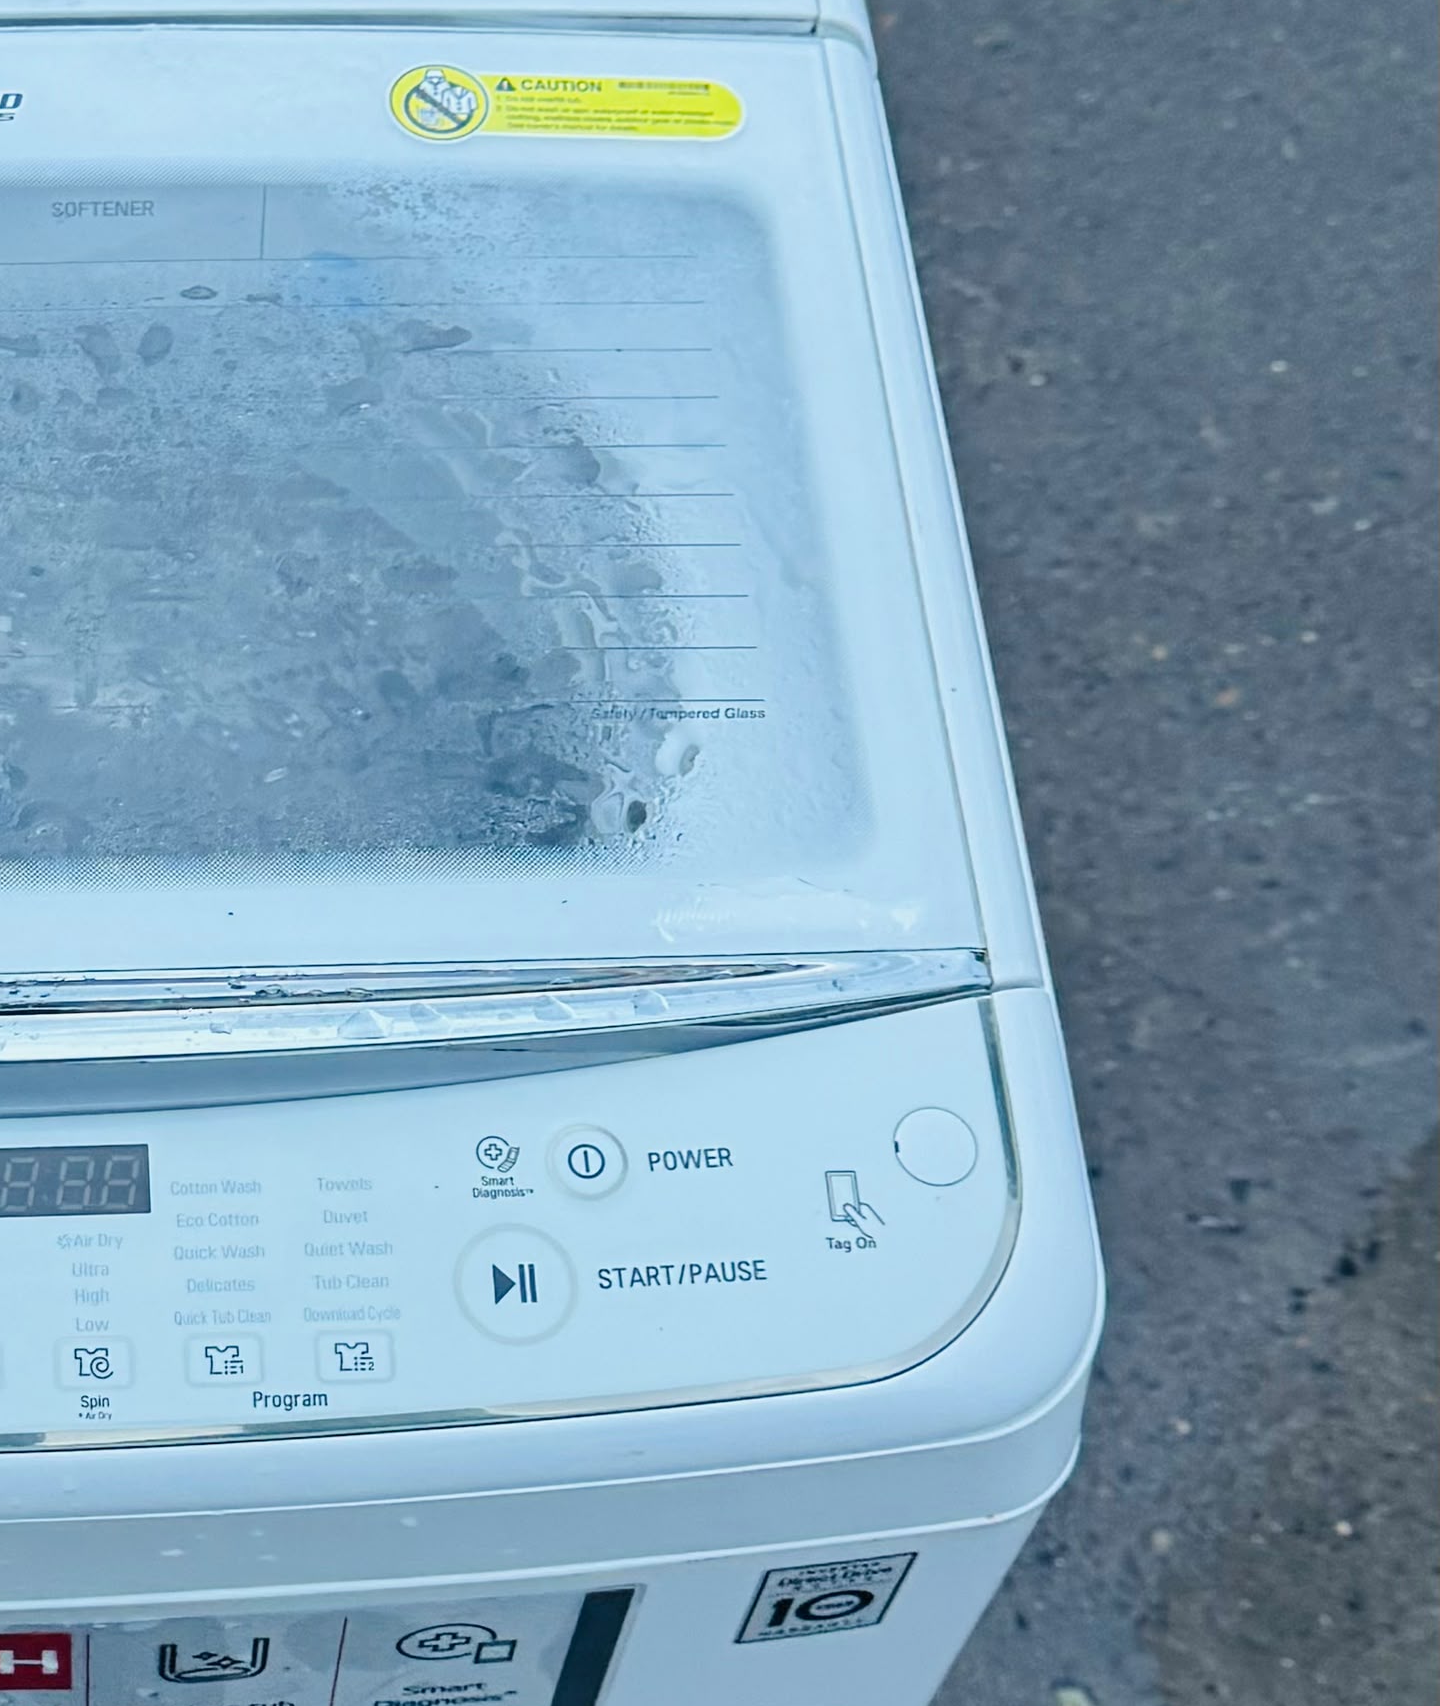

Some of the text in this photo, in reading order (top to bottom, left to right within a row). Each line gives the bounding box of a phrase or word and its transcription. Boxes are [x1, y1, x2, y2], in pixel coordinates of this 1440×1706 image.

[521, 79, 602, 92] CAUTION
[52, 201, 154, 218] SOFTENER
[724, 707, 766, 719] Glass
[648, 1148, 733, 1171] POWER
[170, 1180, 262, 1196] Cotton Wash
[317, 1177, 373, 1192] Towels
[481, 1176, 514, 1186] Smart
[176, 1212, 259, 1228] Eco Cotton
[323, 1209, 368, 1224] Duvet
[73, 1233, 123, 1250] Air Dry
[304, 1241, 393, 1257] Quiet Wash
[825, 1237, 876, 1252] Tag On
[173, 1244, 265, 1261] Quick Wash
[72, 1262, 110, 1277] Ultra
[598, 1260, 768, 1289] START/PAUSE
[186, 1278, 256, 1293] Delicates
[314, 1274, 390, 1290] Tub Clean
[75, 1288, 110, 1305] High
[174, 1310, 208, 1326] Quick
[212, 1309, 235, 1324] Tub
[303, 1305, 401, 1323] Download Cycle
[76, 1316, 109, 1333] Low
[80, 1395, 110, 1410] Spin
[252, 1391, 329, 1411] Program
[767, 1589, 875, 1628] 10
[402, 1682, 486, 1695] Smart
